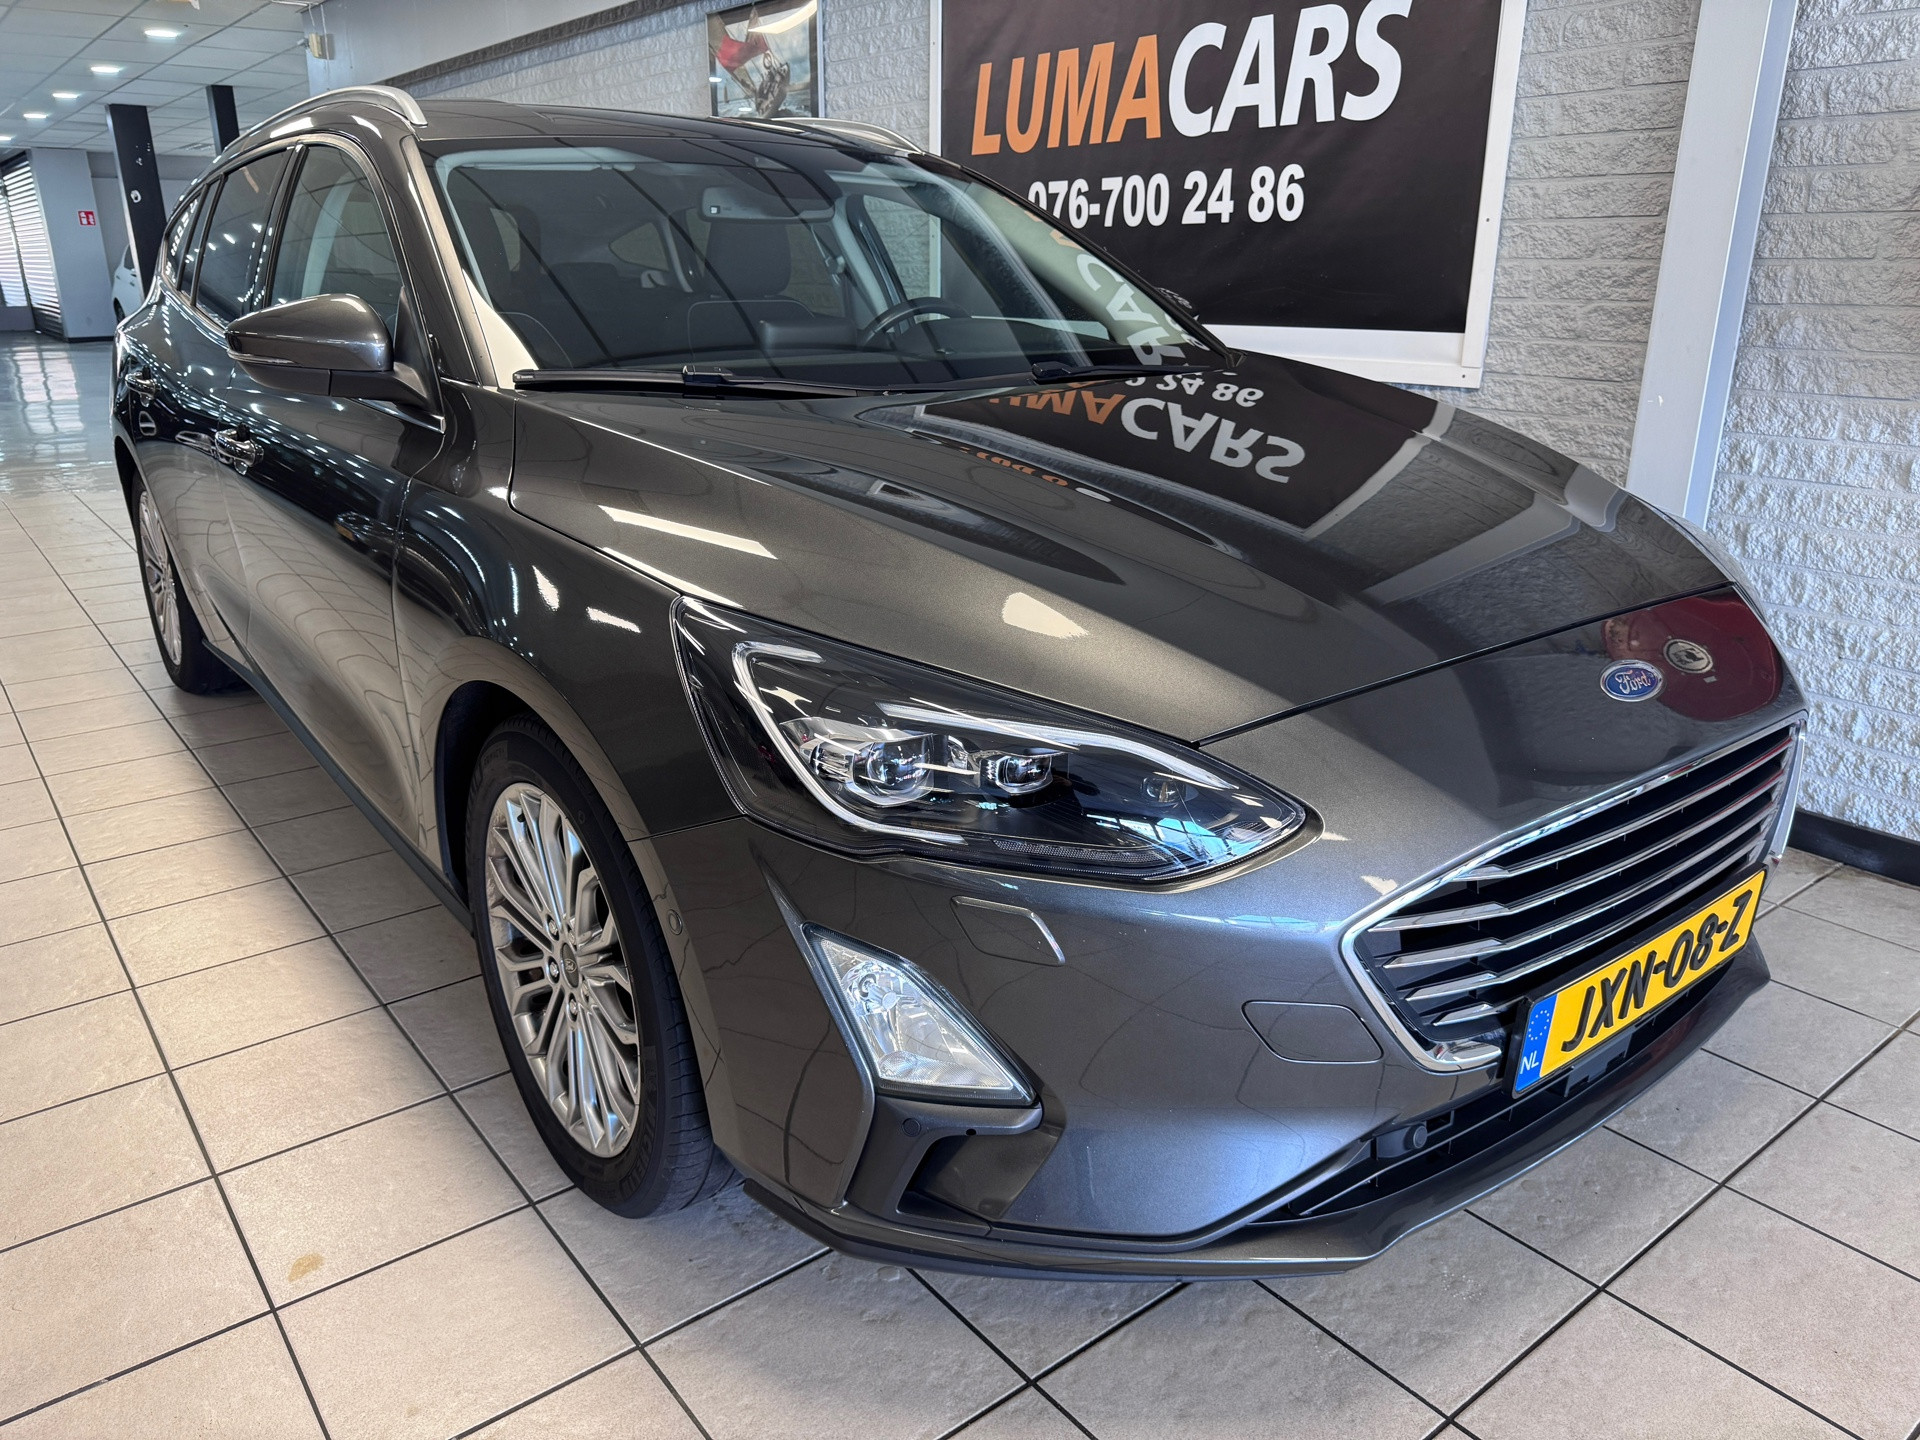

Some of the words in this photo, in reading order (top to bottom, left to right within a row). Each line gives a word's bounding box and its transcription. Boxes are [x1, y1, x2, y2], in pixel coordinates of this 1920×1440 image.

[971, 0, 1410, 155] LUMACARS
[1182, 168, 1234, 225] 24
[1248, 163, 1304, 222] 86
[1615, 670, 1651, 694] Ford
[1561, 889, 1752, 1052] JXN-08-Z
[1520, 1050, 1539, 1074] NL
